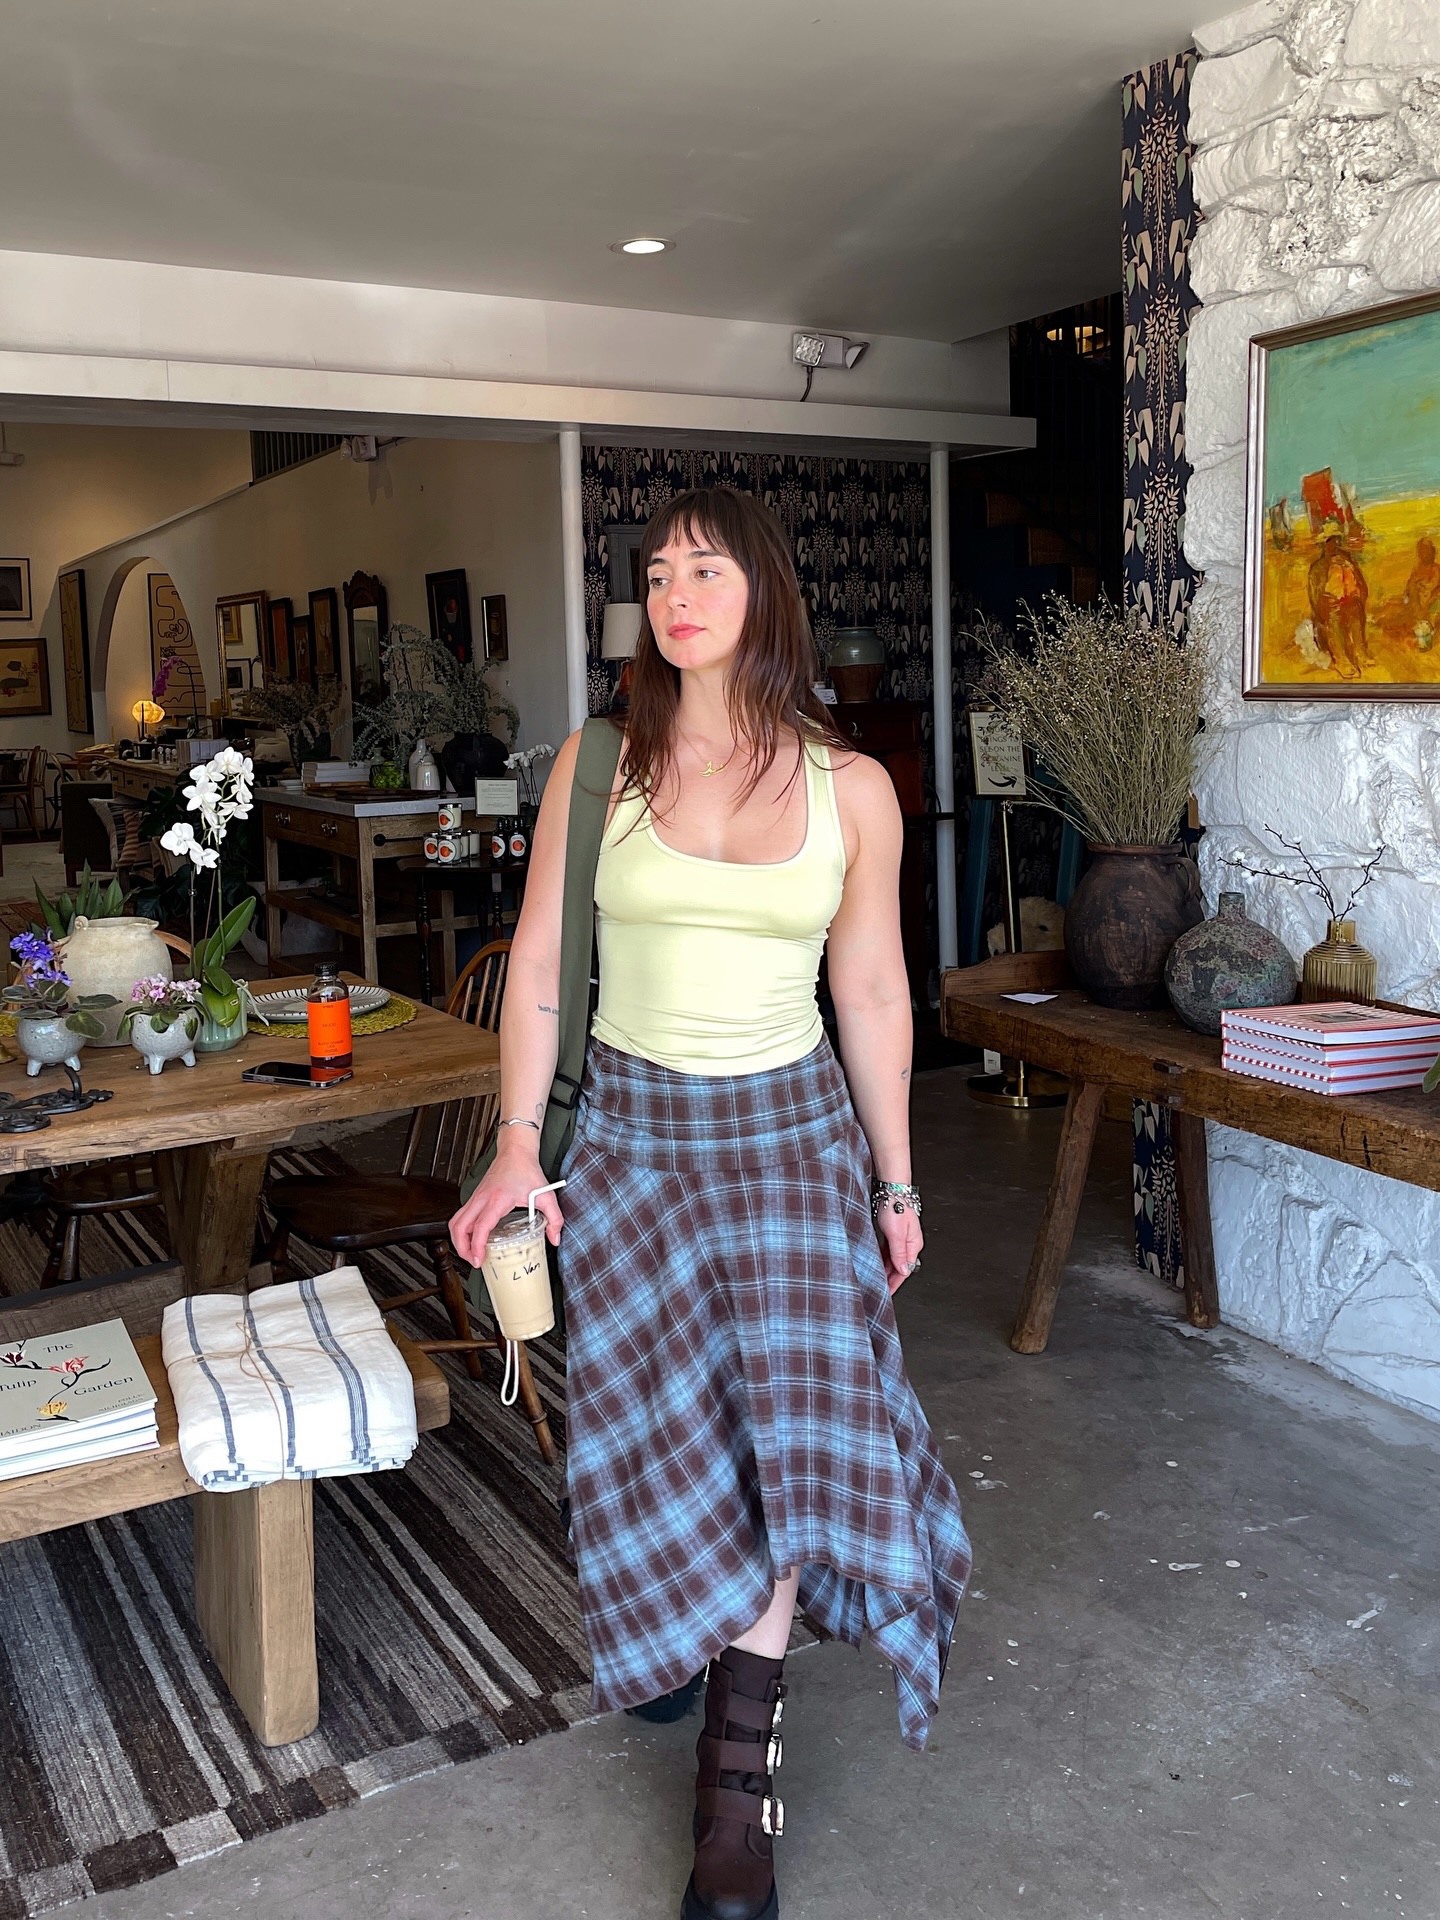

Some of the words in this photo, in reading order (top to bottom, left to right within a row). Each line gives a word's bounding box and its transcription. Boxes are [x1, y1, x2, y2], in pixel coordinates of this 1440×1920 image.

[993, 745, 1005, 753] ON
[1006, 745, 1021, 753] THE
[43, 1342, 74, 1353] The
[0, 1379, 37, 1392] Tulip
[74, 1376, 134, 1396] Garden
